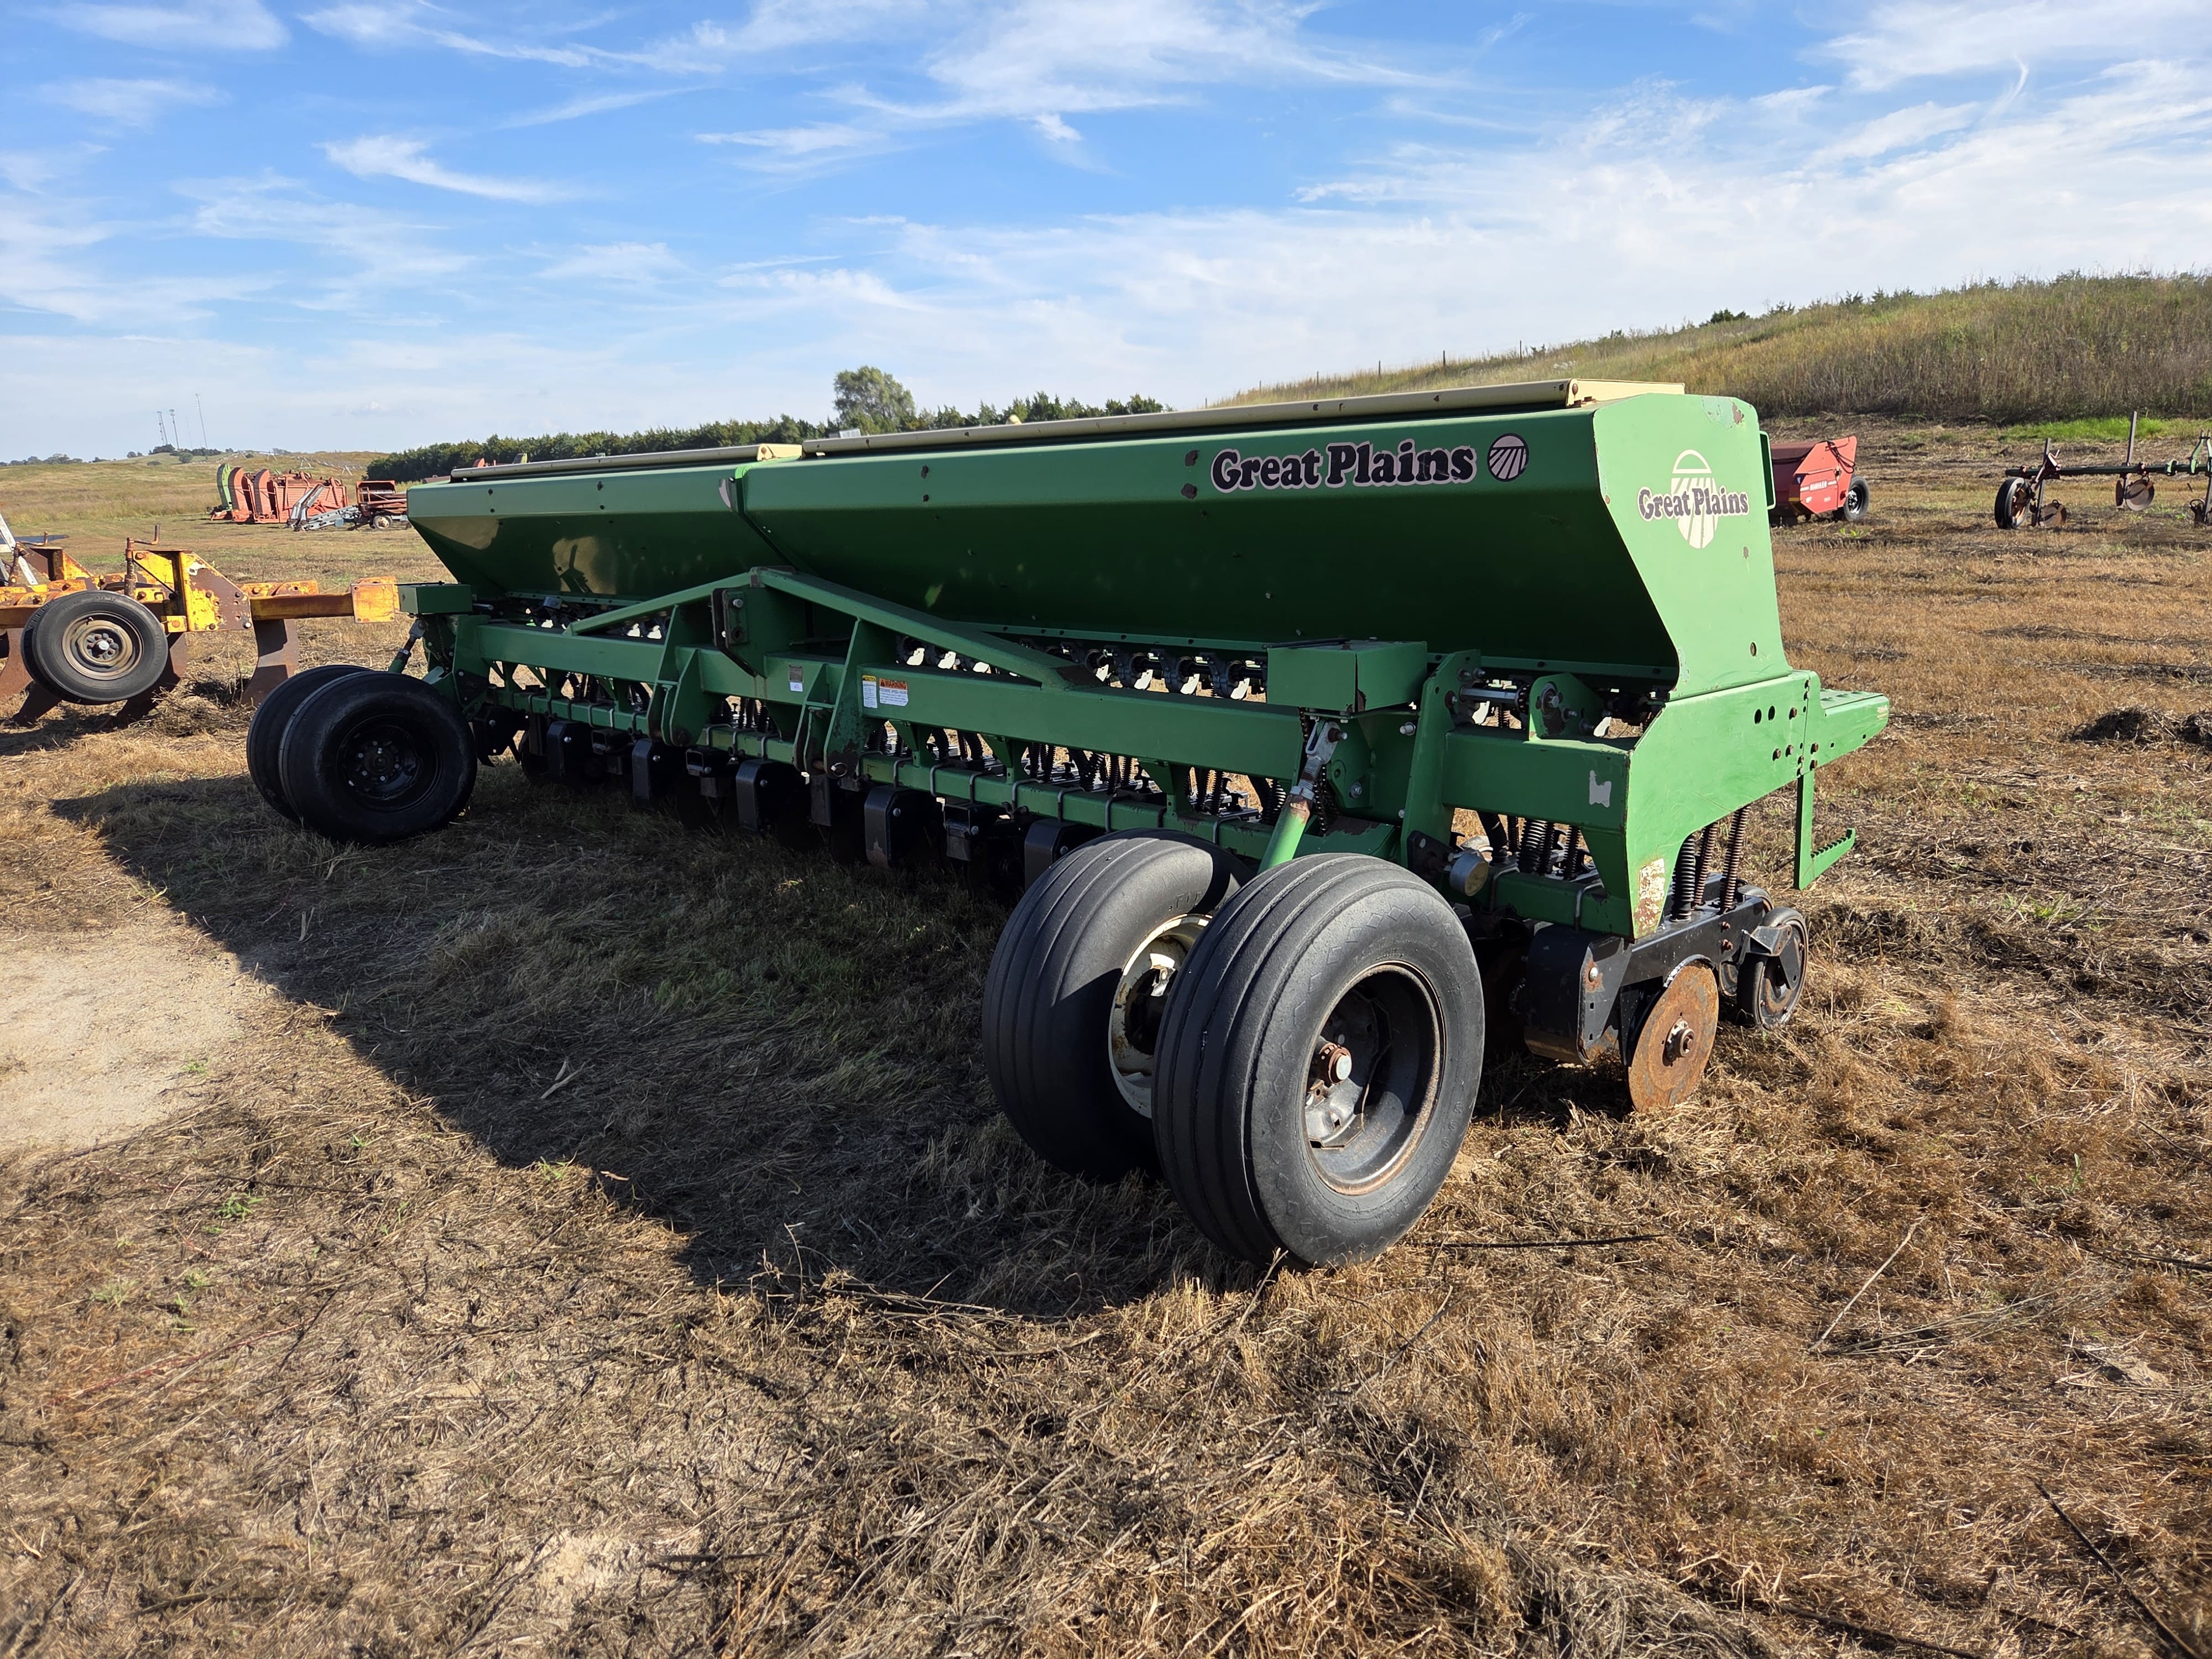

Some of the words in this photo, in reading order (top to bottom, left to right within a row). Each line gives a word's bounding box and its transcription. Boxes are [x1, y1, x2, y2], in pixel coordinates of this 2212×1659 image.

[1212, 448, 1322, 491] Great
[1326, 440, 1475, 487] Plains
[1638, 488, 1691, 520] Great
[1692, 487, 1749, 515] Plains
[885, 680, 907, 689] WARNING
